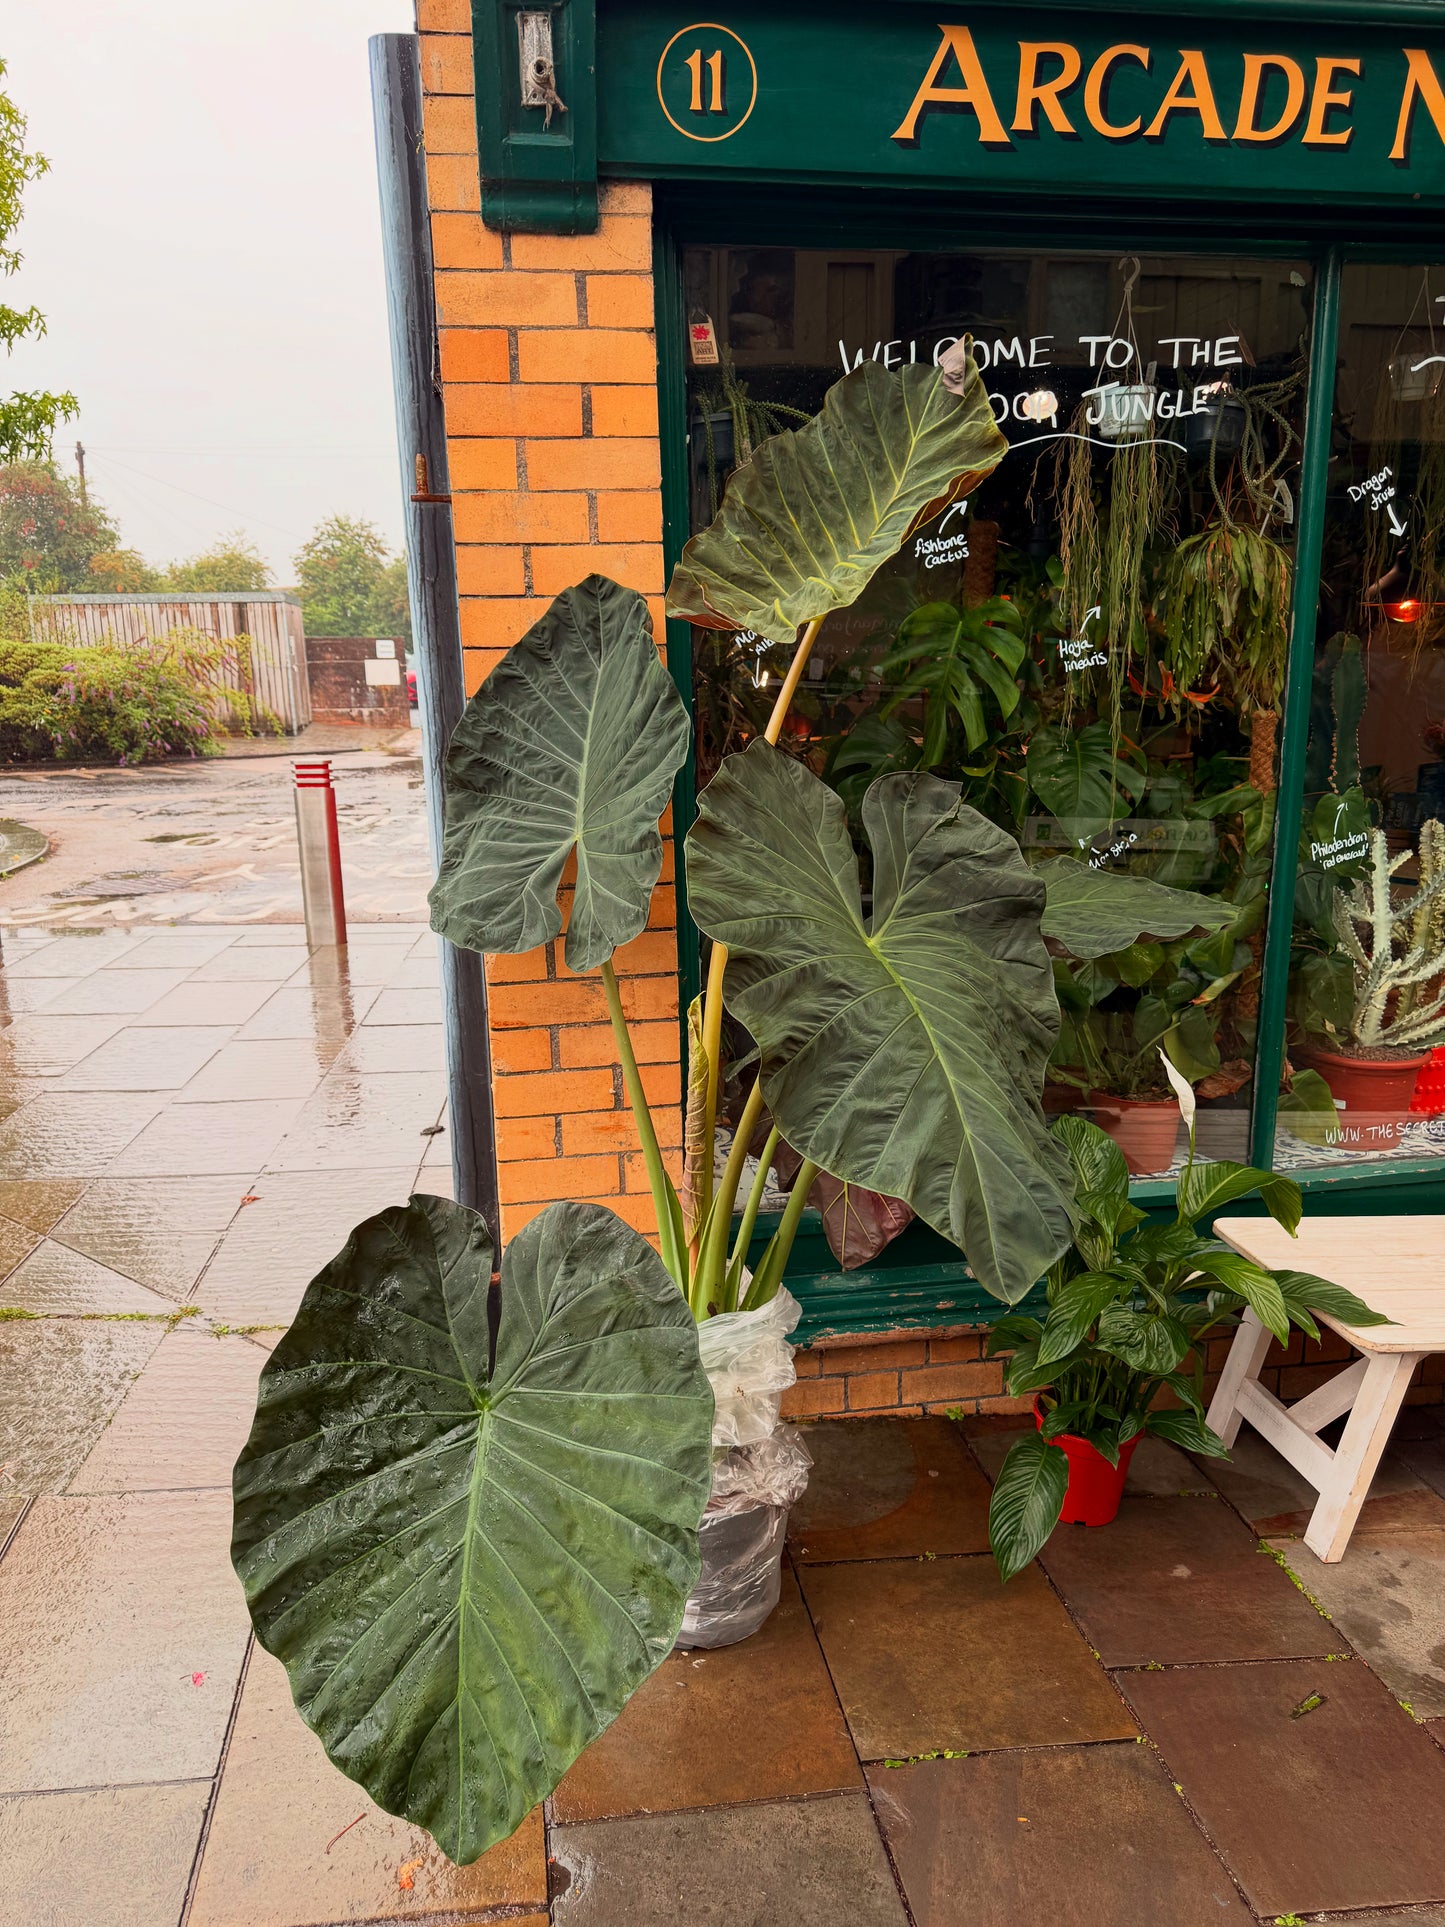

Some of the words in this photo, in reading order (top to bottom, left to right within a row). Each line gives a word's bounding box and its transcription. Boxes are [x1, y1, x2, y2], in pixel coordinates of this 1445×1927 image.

[684, 48, 725, 113] 11
[890, 23, 1362, 147] ARCADE
[1079, 335, 1134, 368] TO
[1158, 335, 1243, 369] THE
[1081, 380, 1211, 425] JUNGLE
[1347, 466, 1393, 502] Dragon
[1371, 486, 1396, 511] fruit
[914, 533, 968, 558] fishbone
[924, 546, 970, 569] Cactus
[1059, 639, 1094, 658] Hoya
[1064, 651, 1108, 673] linearis
[1311, 831, 1368, 861] Philodendron
